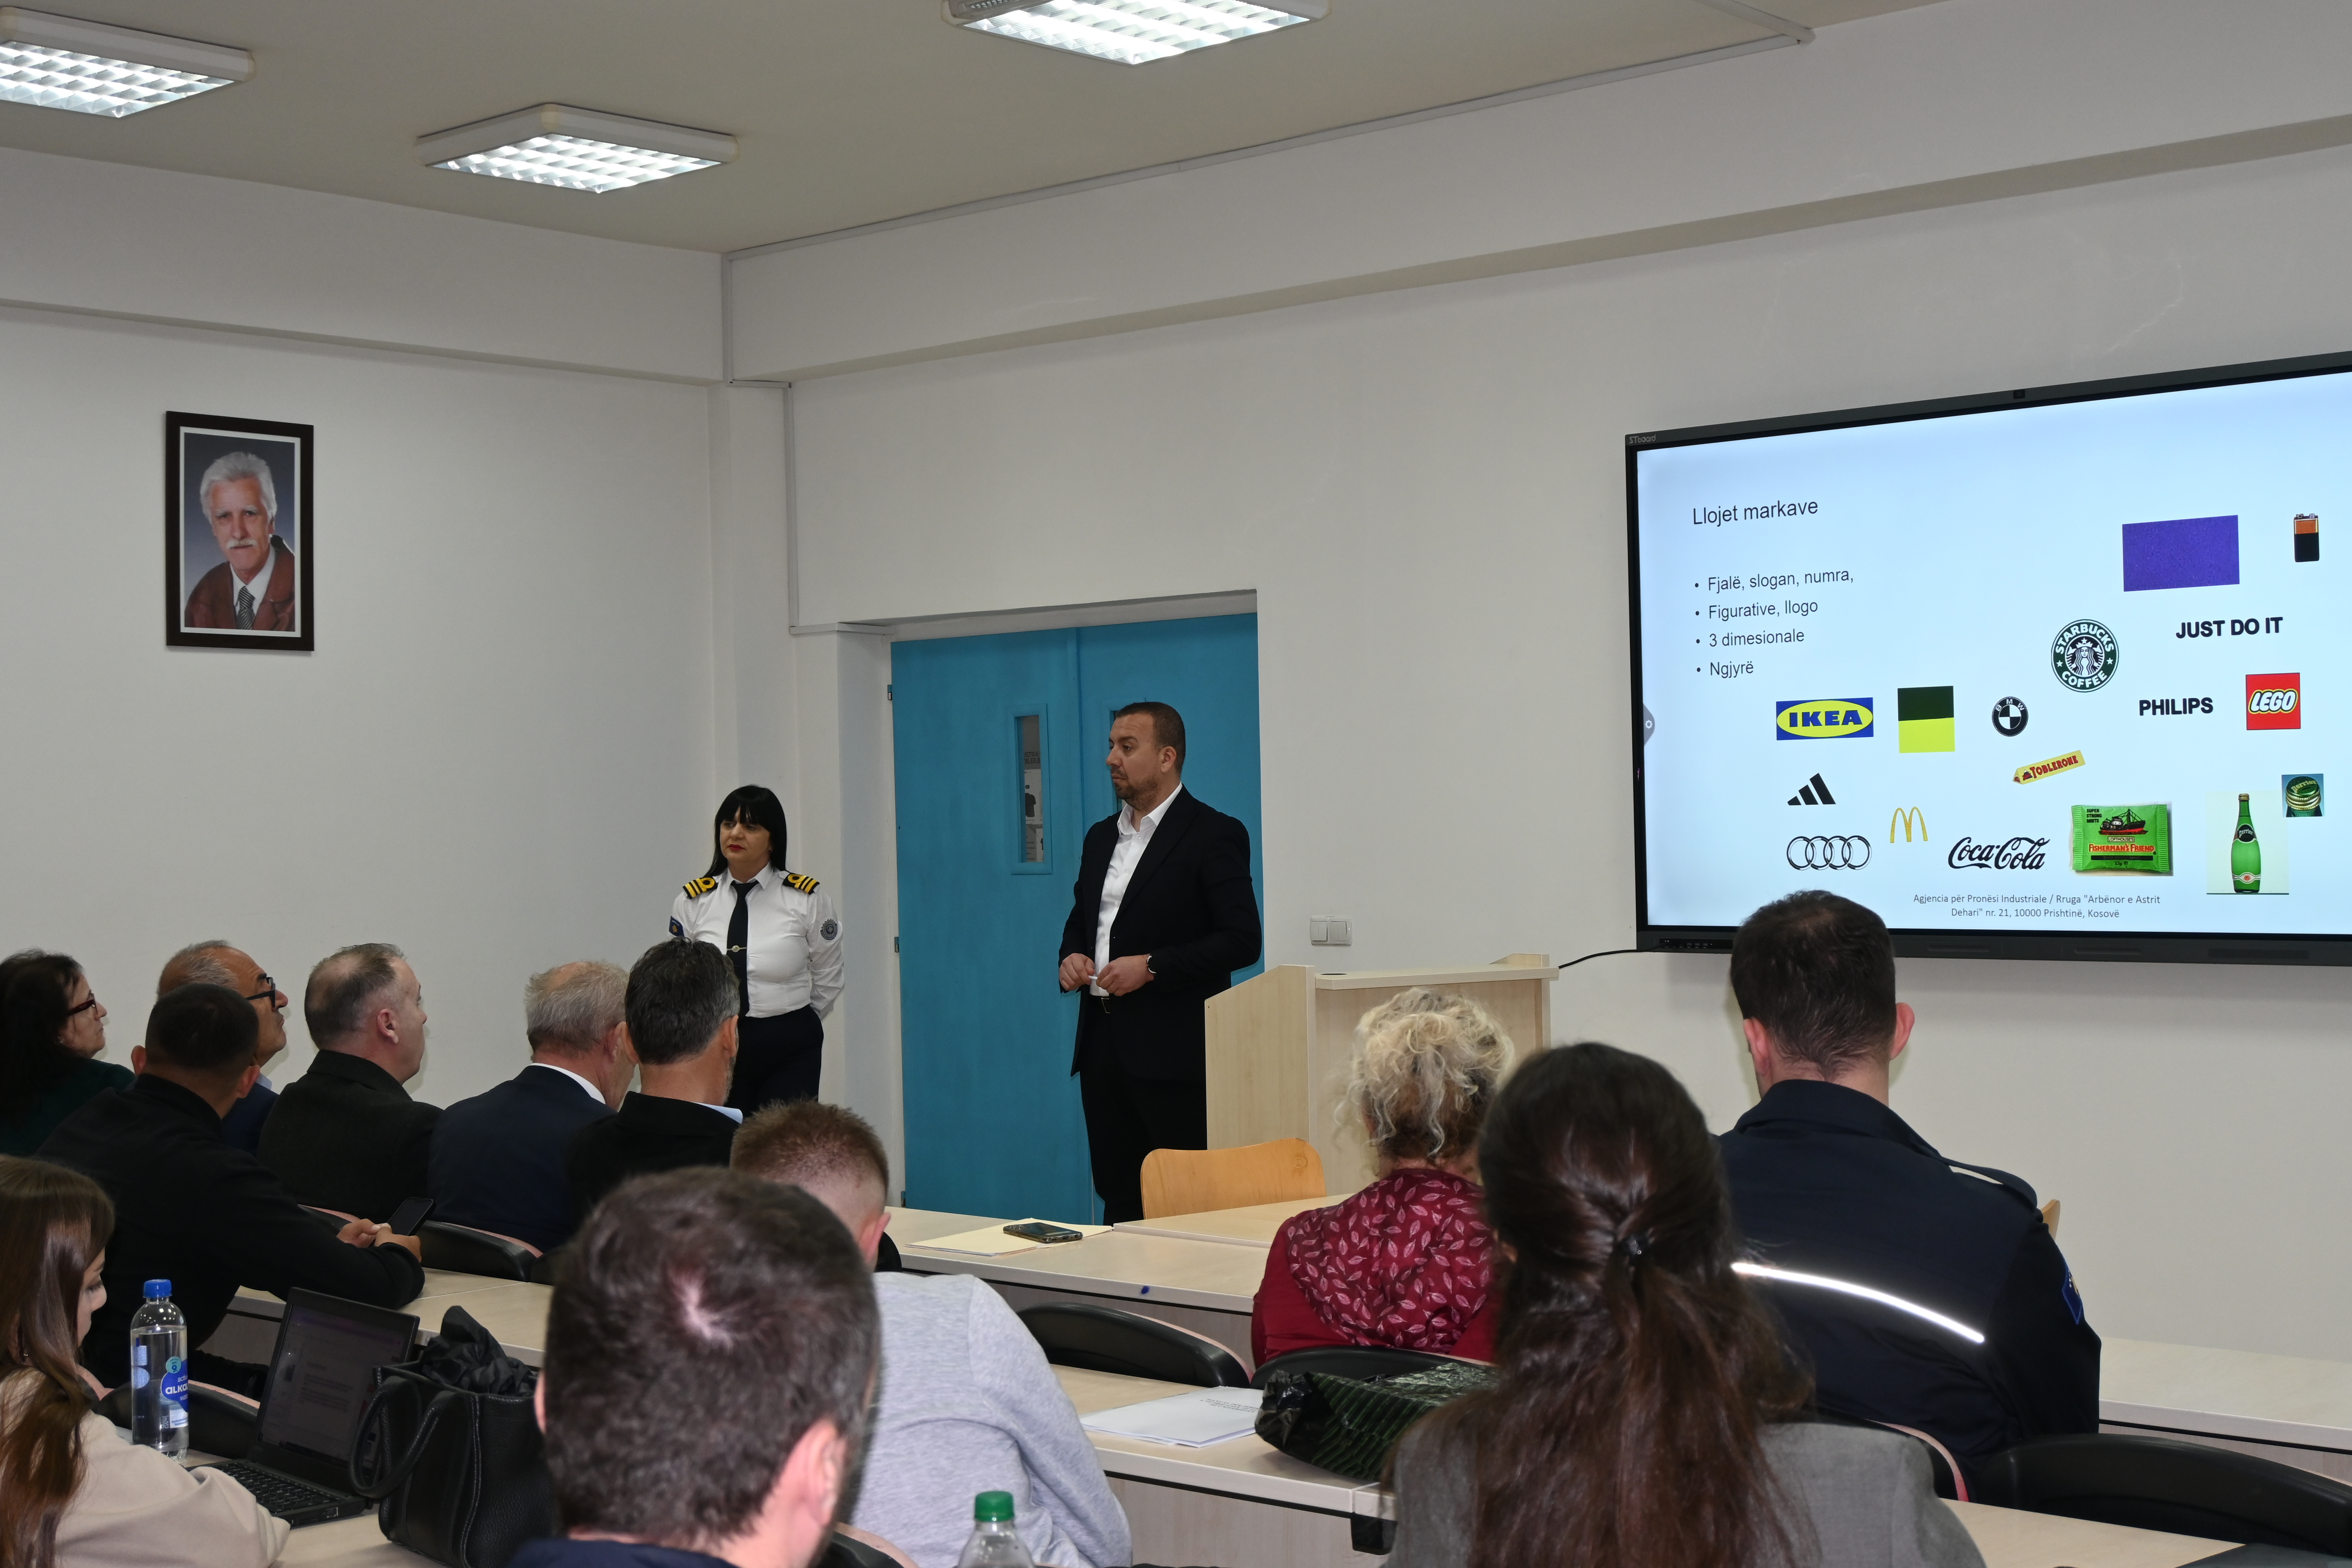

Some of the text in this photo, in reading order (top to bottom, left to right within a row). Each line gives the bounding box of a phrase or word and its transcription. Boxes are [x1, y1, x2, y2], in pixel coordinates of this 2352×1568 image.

[1693, 500, 1818, 527] Llojet markave
[1708, 570, 1854, 594] Fjalë, slogan, numra,
[1709, 600, 1818, 621] Figurative, llogo
[1709, 628, 1805, 647] 3 dimesionale
[2176, 617, 2283, 639] JUST DO IT
[2055, 624, 2114, 654] STARBUCKS
[1710, 661, 1754, 678] Ngjyrë
[2062, 670, 2107, 688] COFFEE
[1995, 699, 2025, 711] BMW
[2139, 697, 2213, 716] PHILIPS
[2250, 690, 2297, 713] LEGO
[1789, 710, 1863, 727] IKEA
[2030, 755, 2079, 779] TOBLERONE
[1948, 836, 2050, 870] Coca-Cola
[2089, 843, 2154, 852] FISHERMAN'S FRIEND
[1914, 894, 1948, 904] Agjencia
[1951, 895, 1965, 904] për
[1968, 895, 1998, 903] Pronësi
[2001, 895, 2047, 903] Industriale
[2056, 895, 2081, 905] Rruga
[2084, 895, 2125, 904] "Arbënor
[2136, 895, 2161, 904] Astrit
[1951, 908, 1983, 916] Dehari"
[1998, 909, 2012, 917] 21,
[2014, 909, 2041, 917] 10000
[2044, 909, 2085, 918] Prishtinë,
[2088, 909, 2119, 917] Kosovë
